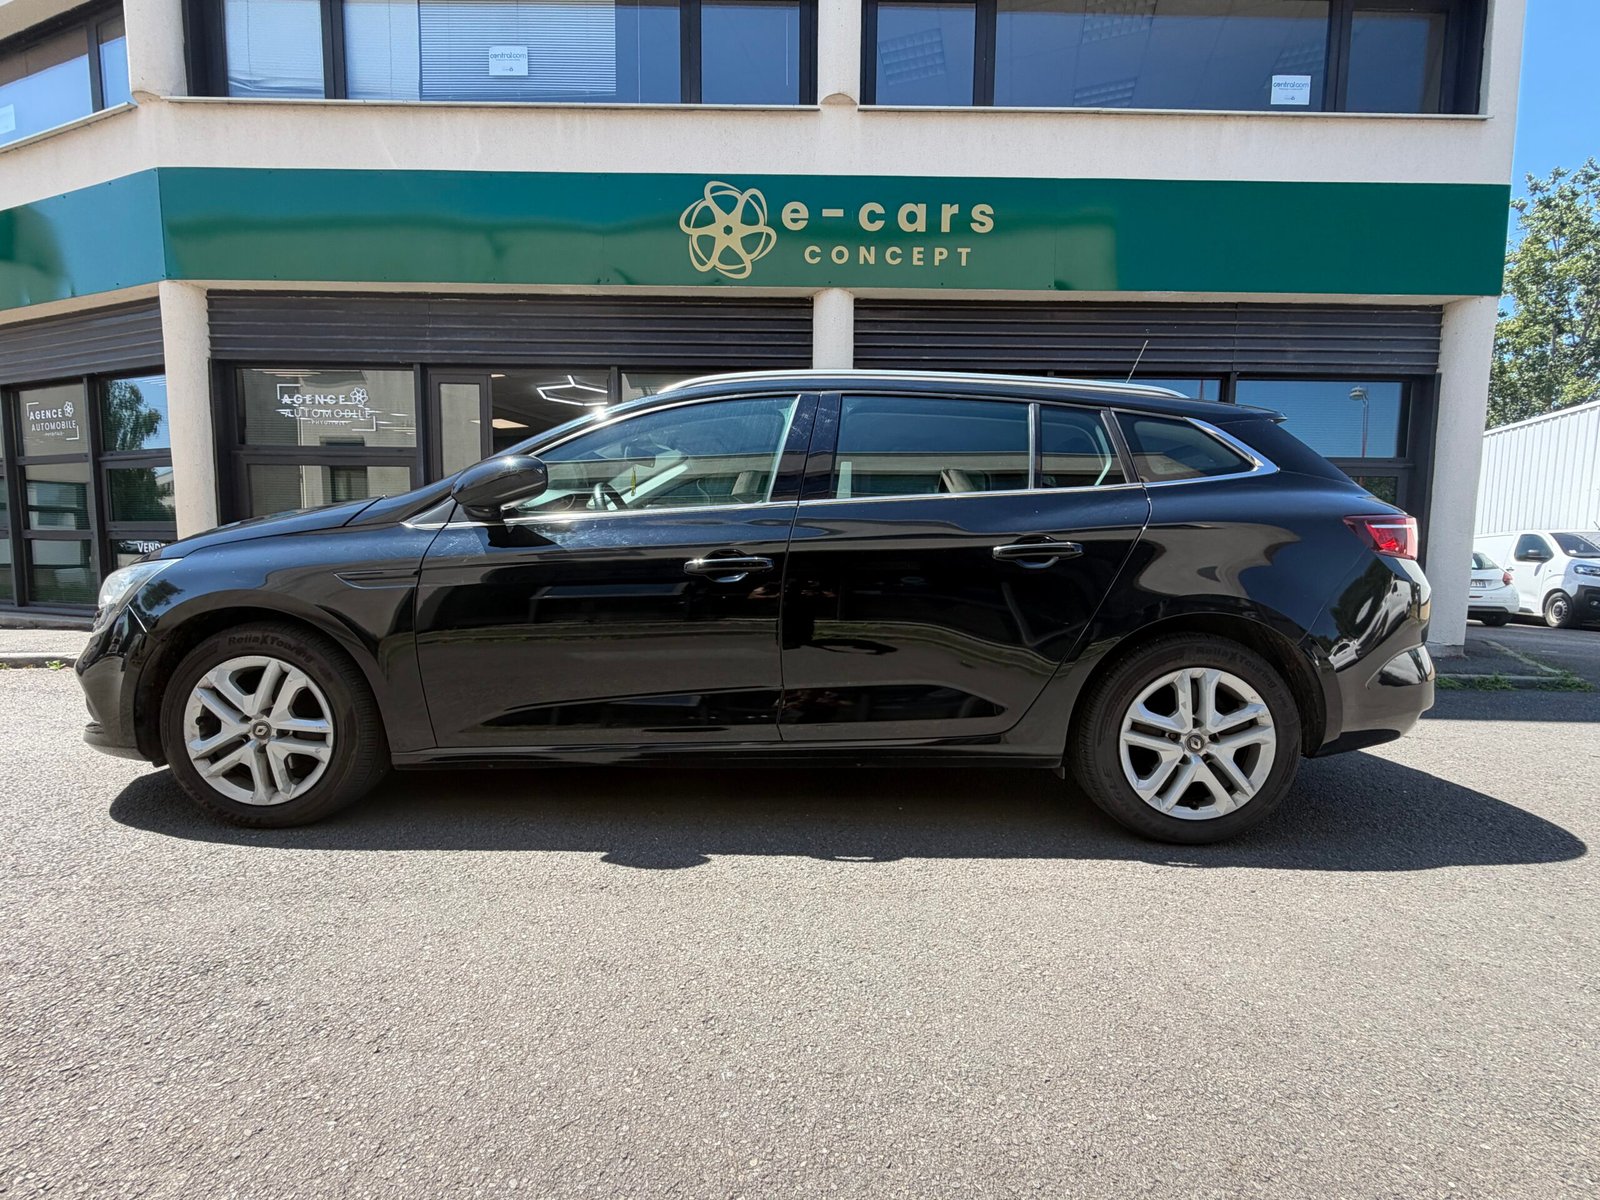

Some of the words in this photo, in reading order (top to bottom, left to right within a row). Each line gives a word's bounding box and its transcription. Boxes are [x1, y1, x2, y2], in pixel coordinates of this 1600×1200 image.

[804, 245, 971, 267] CONCEPT
[281, 394, 346, 405] AGENCE
[29, 409, 63, 420] AGENCE
[285, 408, 371, 418] AUTOMOBILE
[31, 420, 76, 431] AUTOMOBILE
